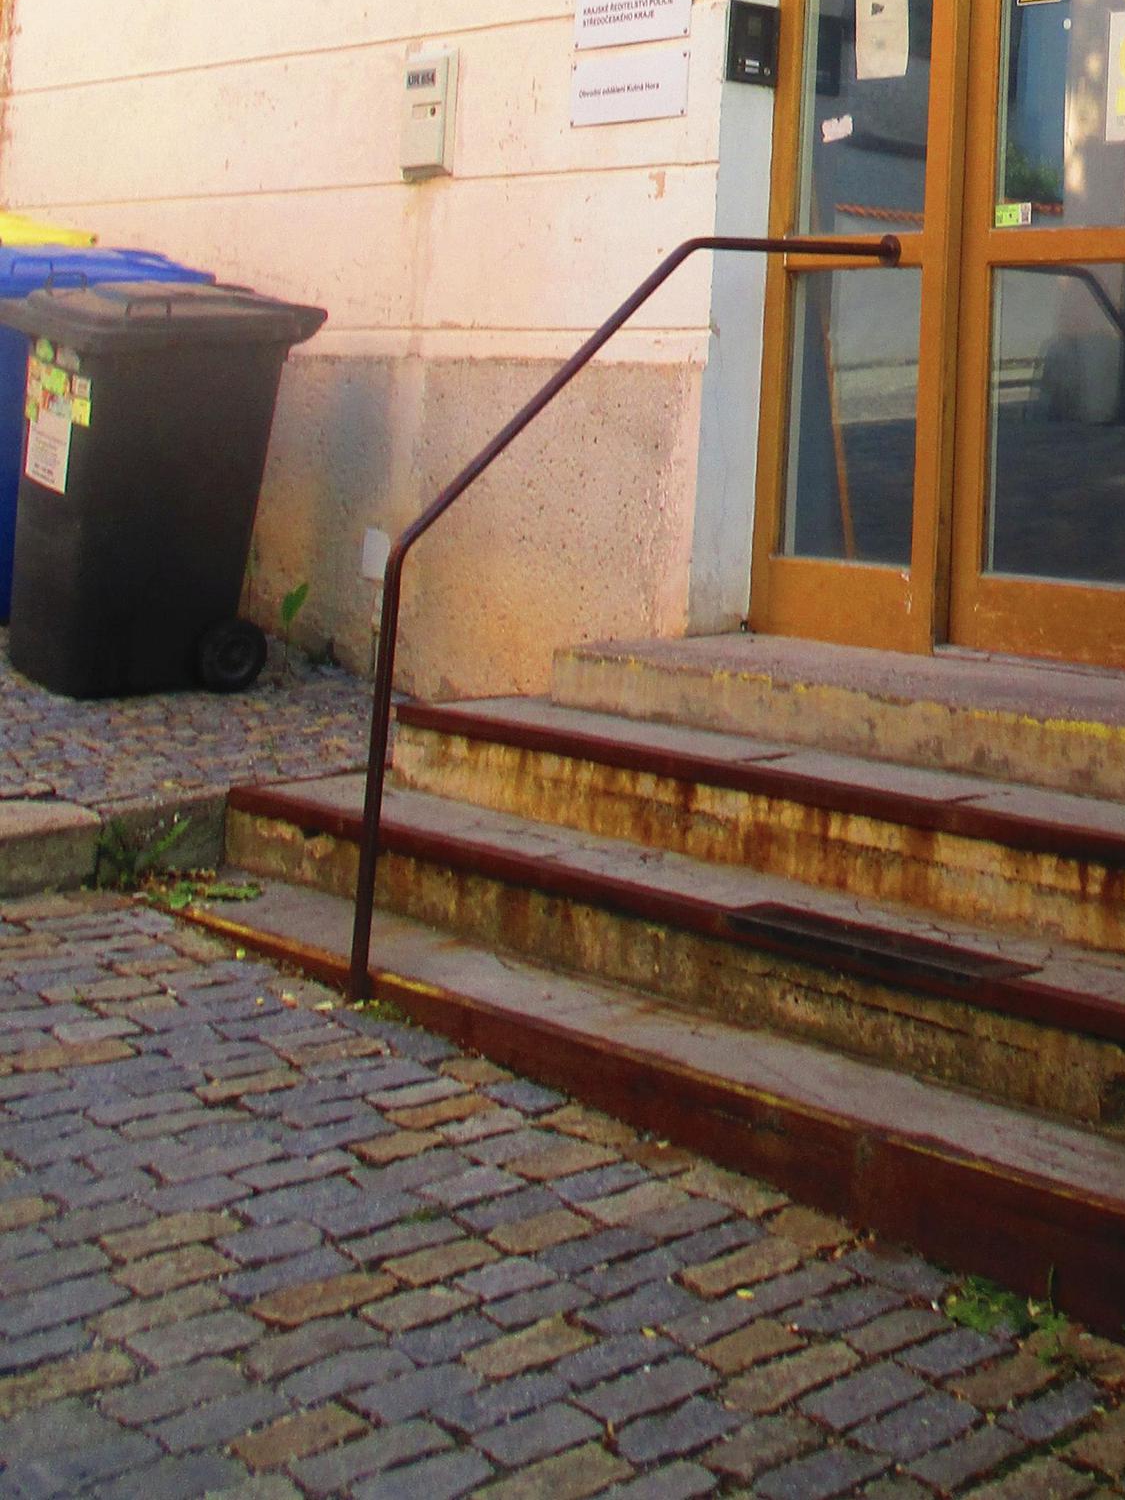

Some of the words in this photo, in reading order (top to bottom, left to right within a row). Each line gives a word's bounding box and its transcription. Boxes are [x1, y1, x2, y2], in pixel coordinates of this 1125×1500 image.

[583, 4, 609, 16] KRAJSKÉ
[633, 10, 655, 21] KRAJE
[626, 83, 644, 93] Kutná
[644, 82, 660, 91] Hora
